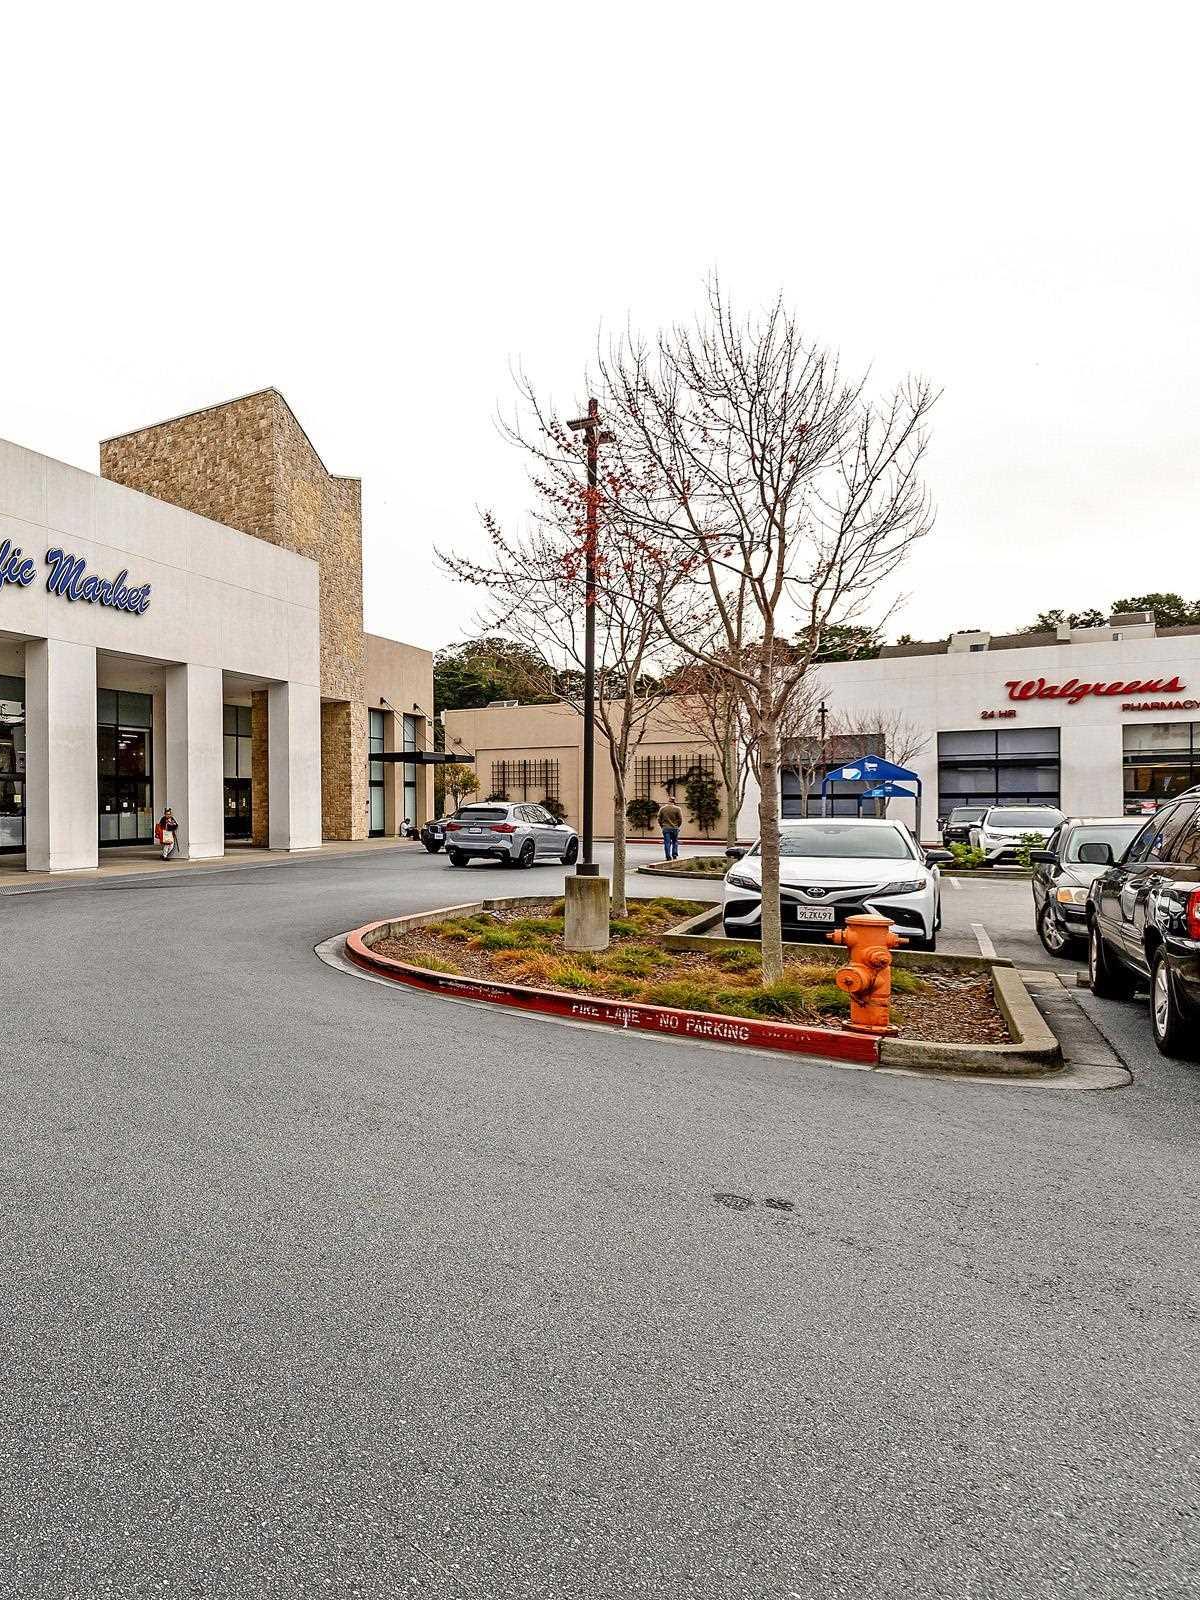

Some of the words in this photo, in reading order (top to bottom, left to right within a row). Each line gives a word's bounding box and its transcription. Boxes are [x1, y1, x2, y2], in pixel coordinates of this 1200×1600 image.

[45, 547, 152, 615] Market
[1004, 676, 1186, 705] Walgreens
[980, 710, 995, 720] 24
[998, 709, 1017, 719] HR
[1121, 699, 1200, 712] PHARMACY
[606, 1007, 641, 1025] LANE
[657, 1013, 679, 1030] NO
[685, 1018, 750, 1041] PARKING
